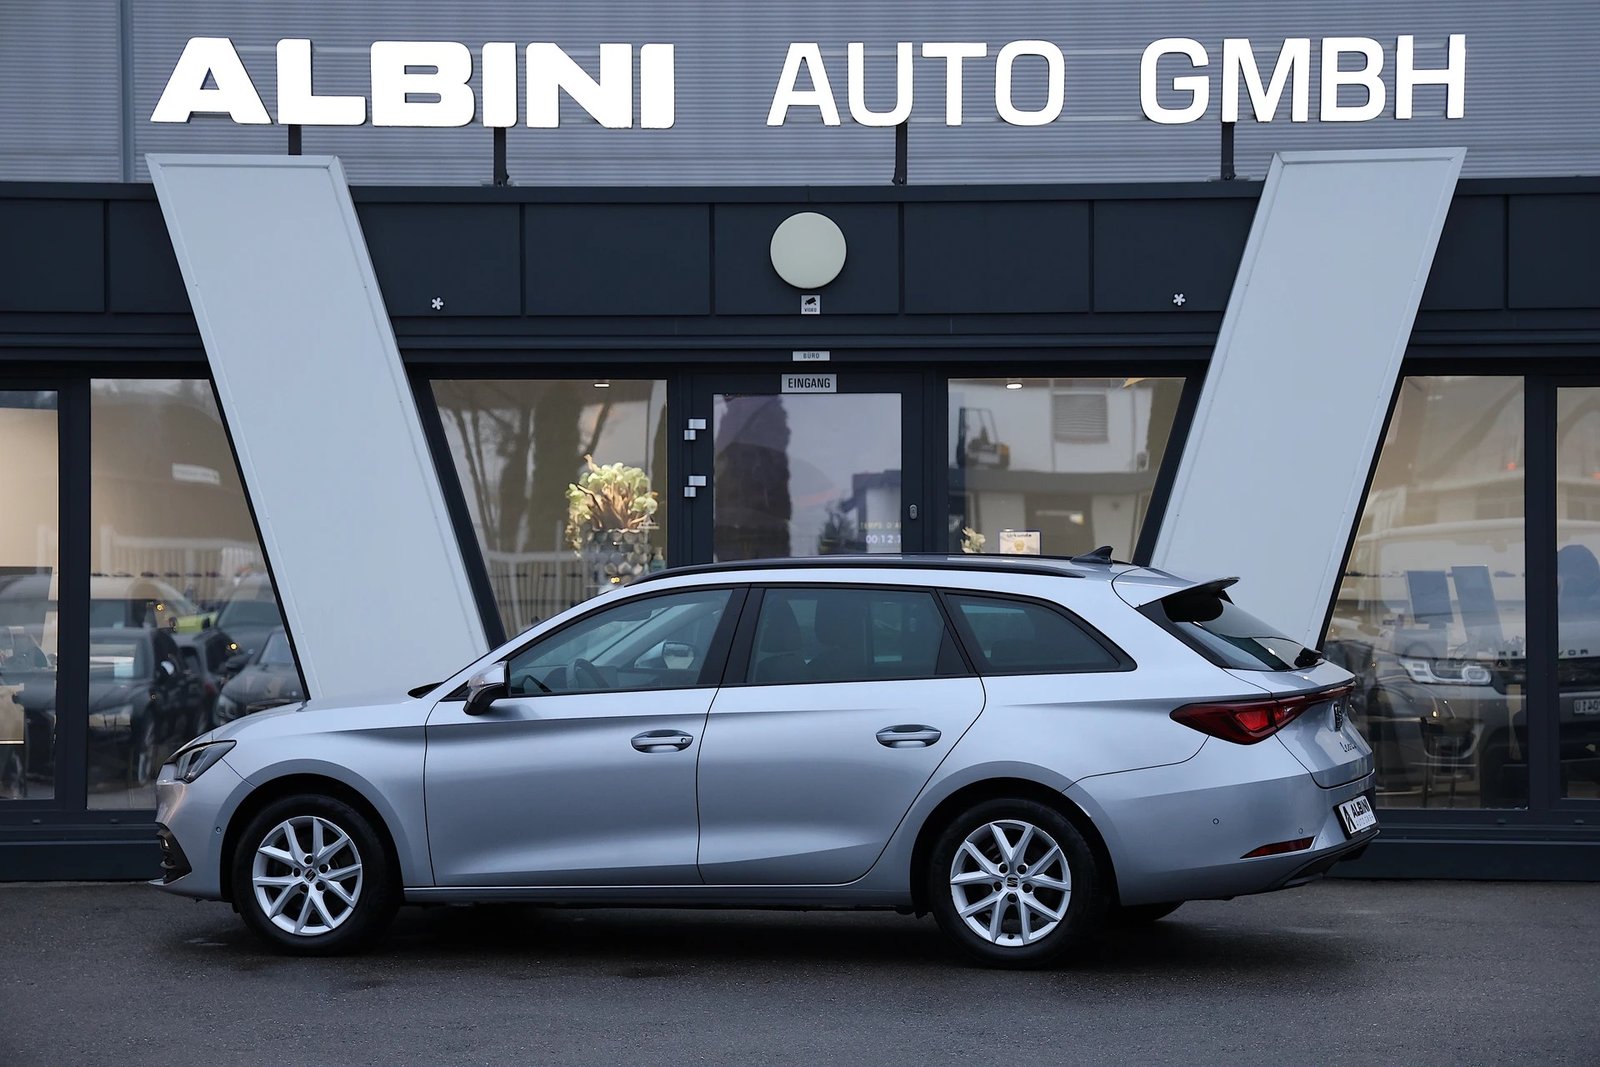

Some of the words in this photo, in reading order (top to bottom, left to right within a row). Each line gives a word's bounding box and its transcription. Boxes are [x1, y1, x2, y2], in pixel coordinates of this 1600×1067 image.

[150, 37, 676, 129] ALBINI
[766, 41, 1066, 127] AUTO
[1140, 34, 1467, 124] GMBH
[788, 378, 831, 389] EINGANG
